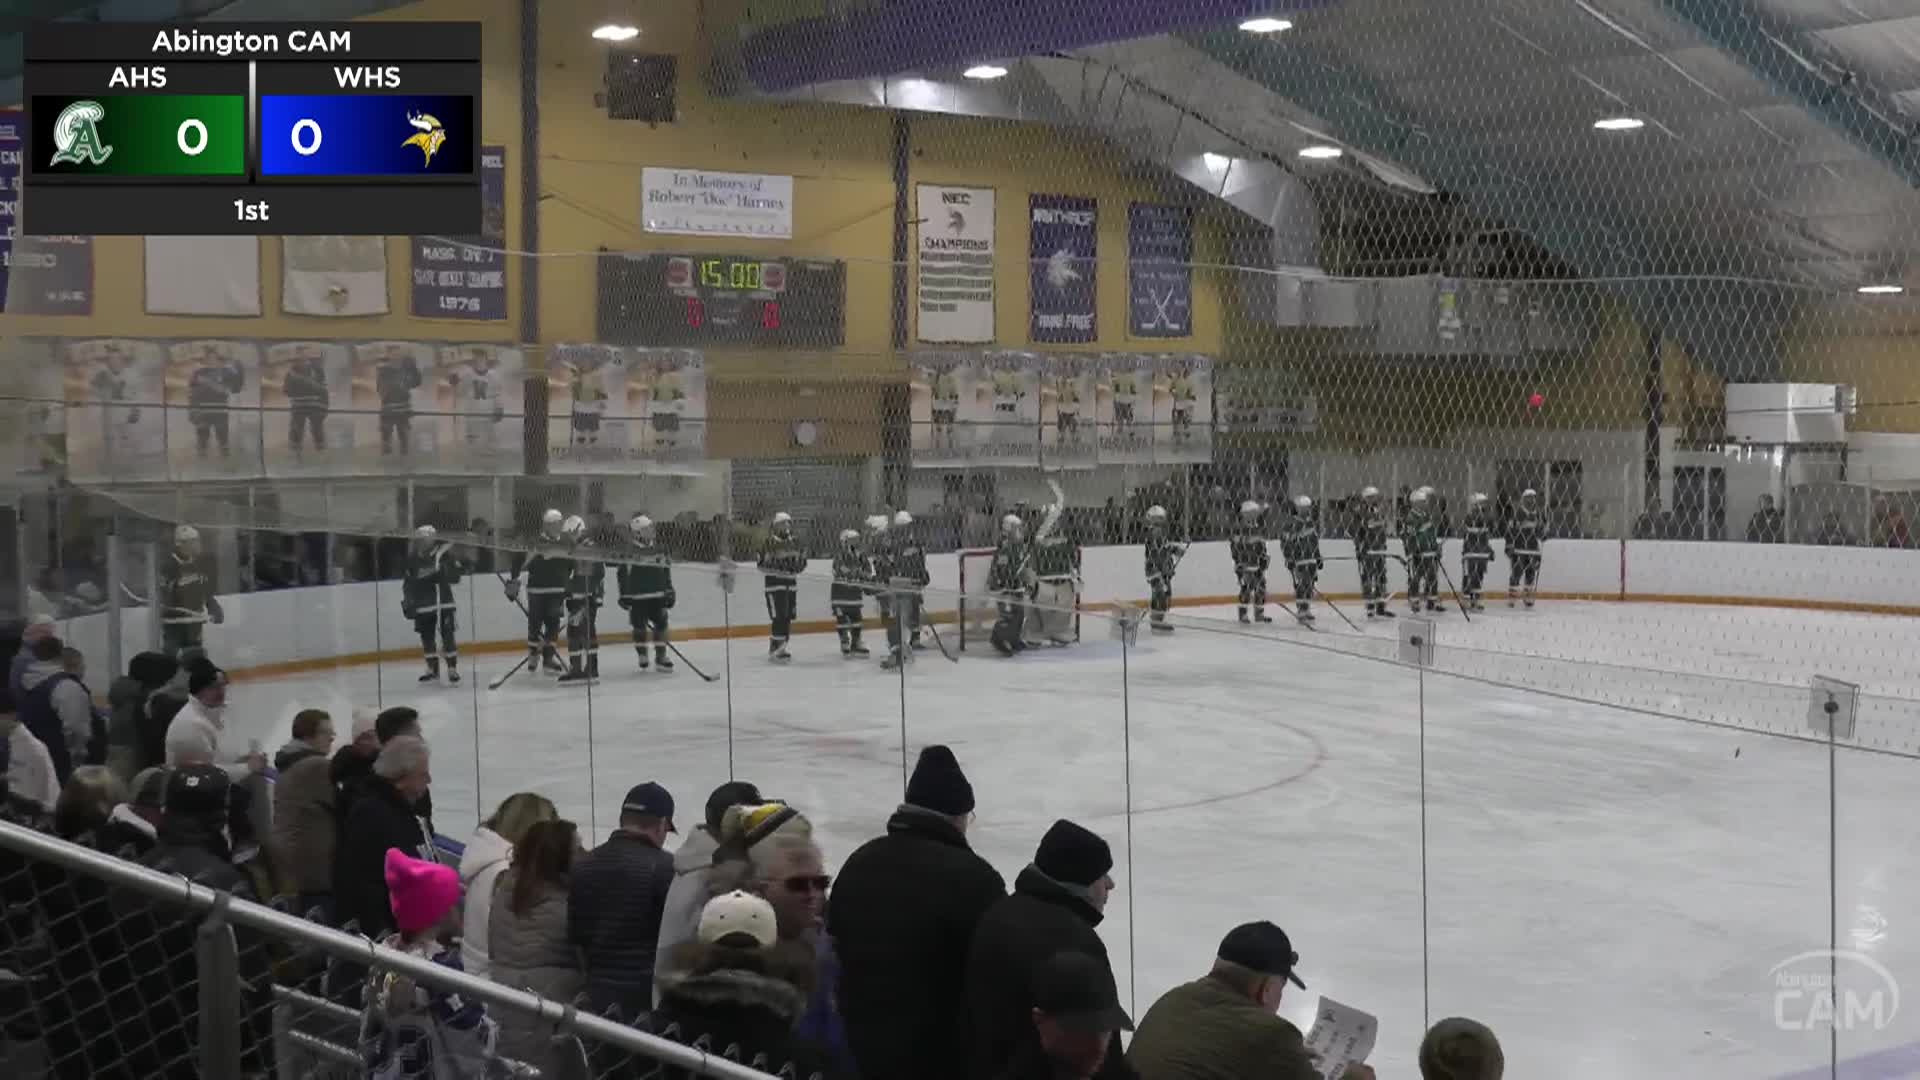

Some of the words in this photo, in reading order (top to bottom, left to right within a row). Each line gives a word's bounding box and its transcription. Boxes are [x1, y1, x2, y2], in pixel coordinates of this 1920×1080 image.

[750, 177, 764, 192] of
[942, 191, 971, 205] NEC
[924, 236, 989, 251] CHAMPIONS
